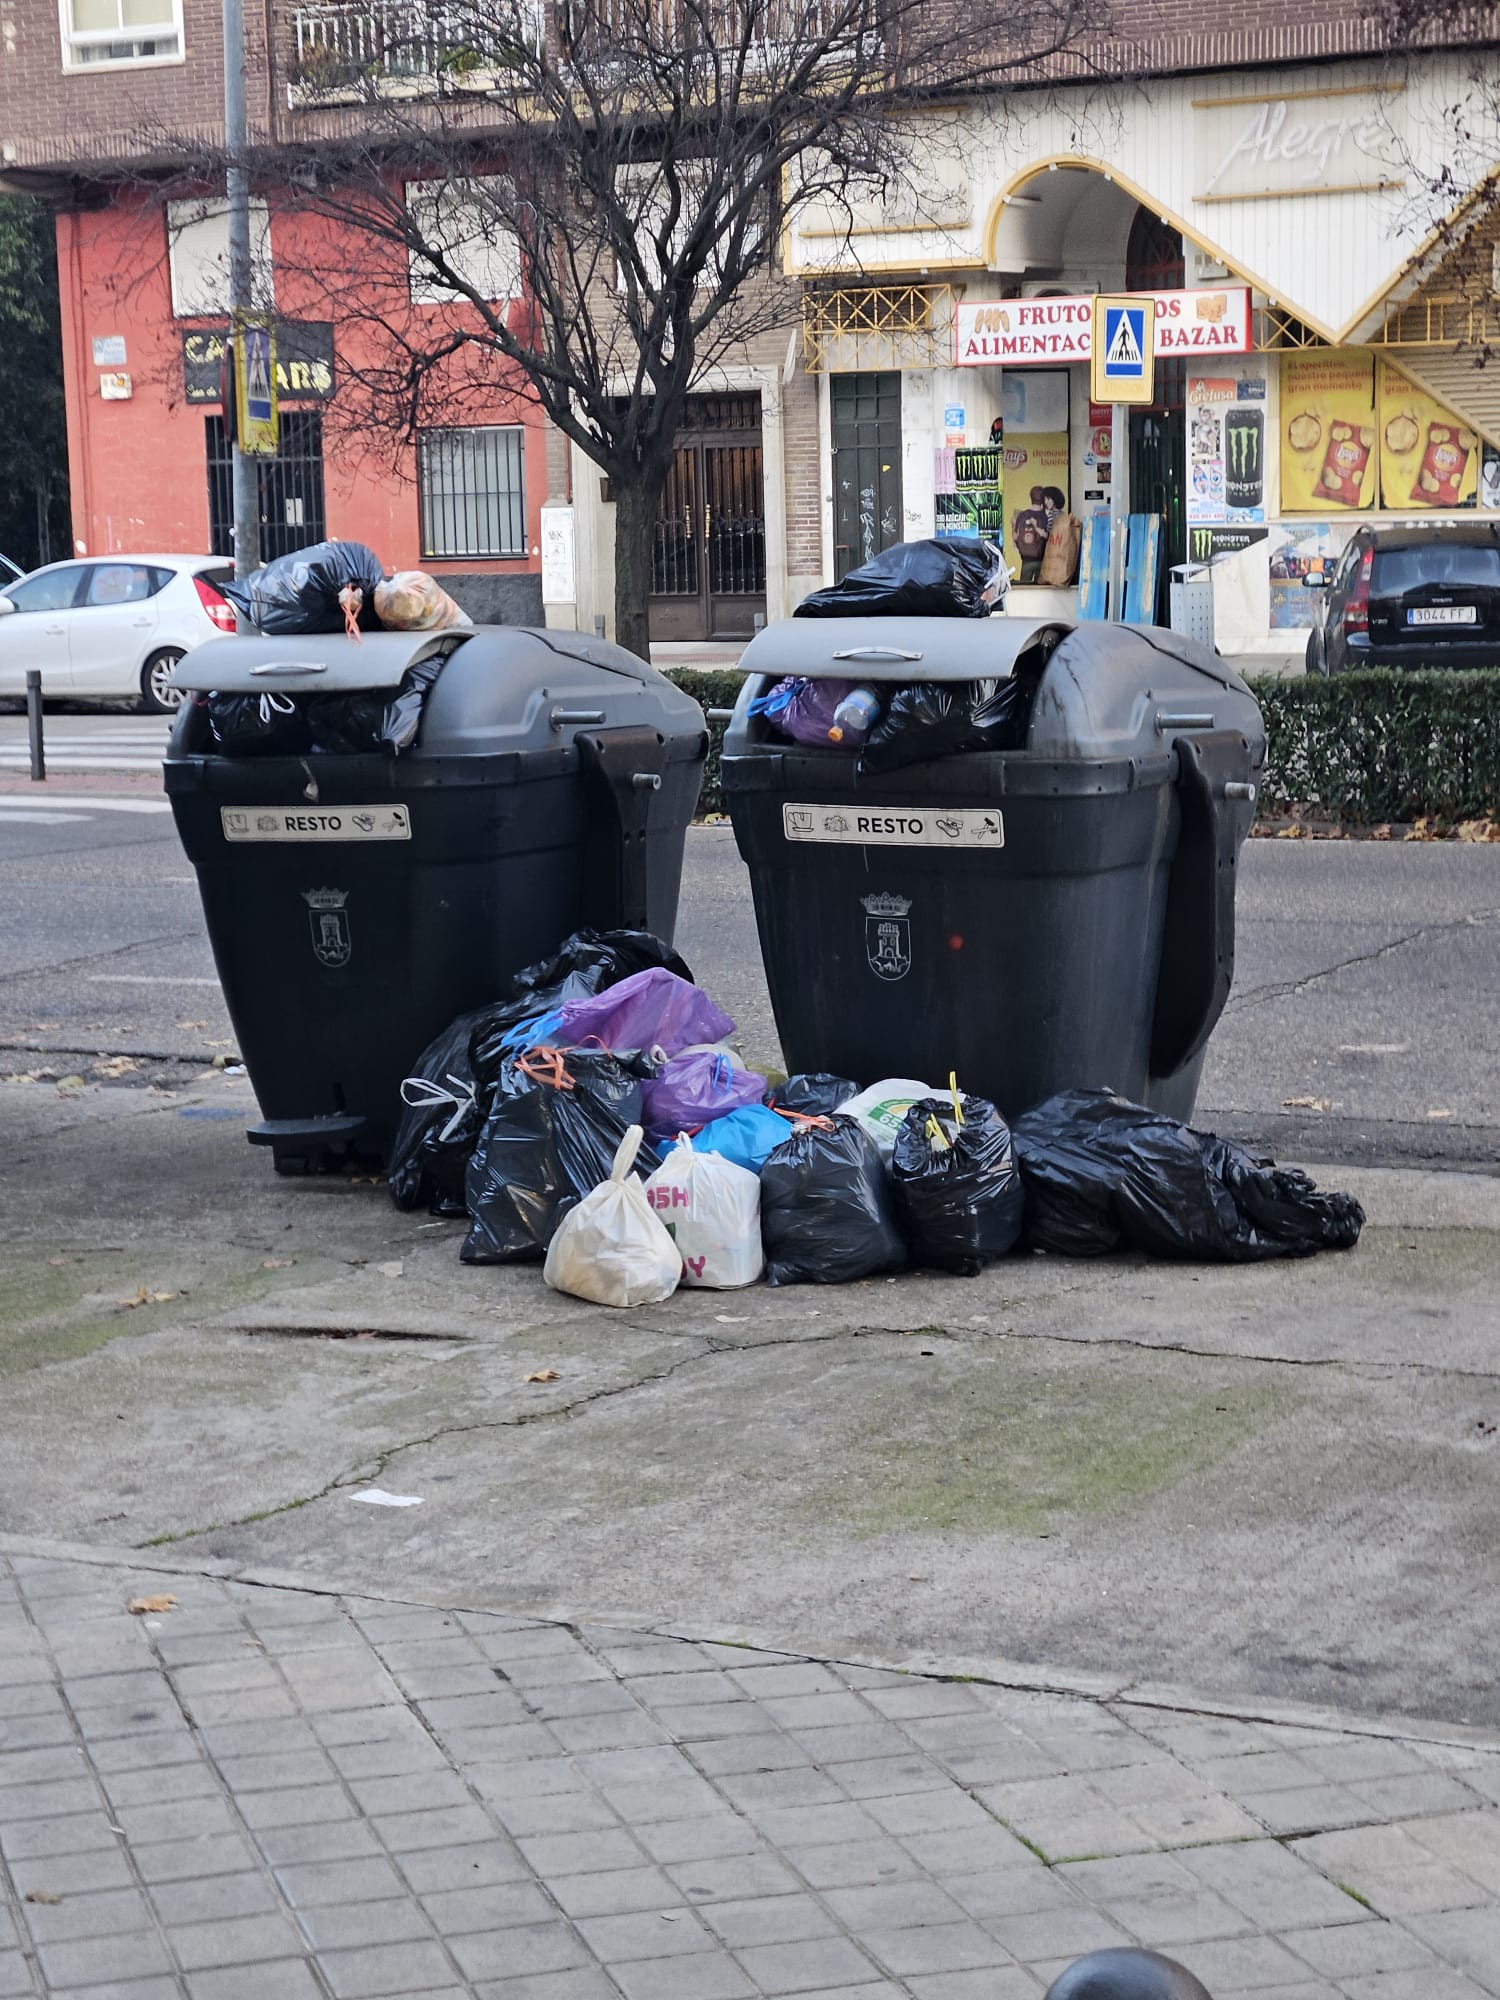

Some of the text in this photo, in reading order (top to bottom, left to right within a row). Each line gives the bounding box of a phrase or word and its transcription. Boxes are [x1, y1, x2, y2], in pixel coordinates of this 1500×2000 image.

[1206, 100, 1386, 191] Alegre
[1018, 304, 1091, 326] FRUTO
[965, 325, 1239, 357] ALIMENTAC BAZAR
[1212, 533, 1251, 543] MONSTER
[284, 814, 342, 832] RESTO
[857, 816, 923, 835] RESTO
